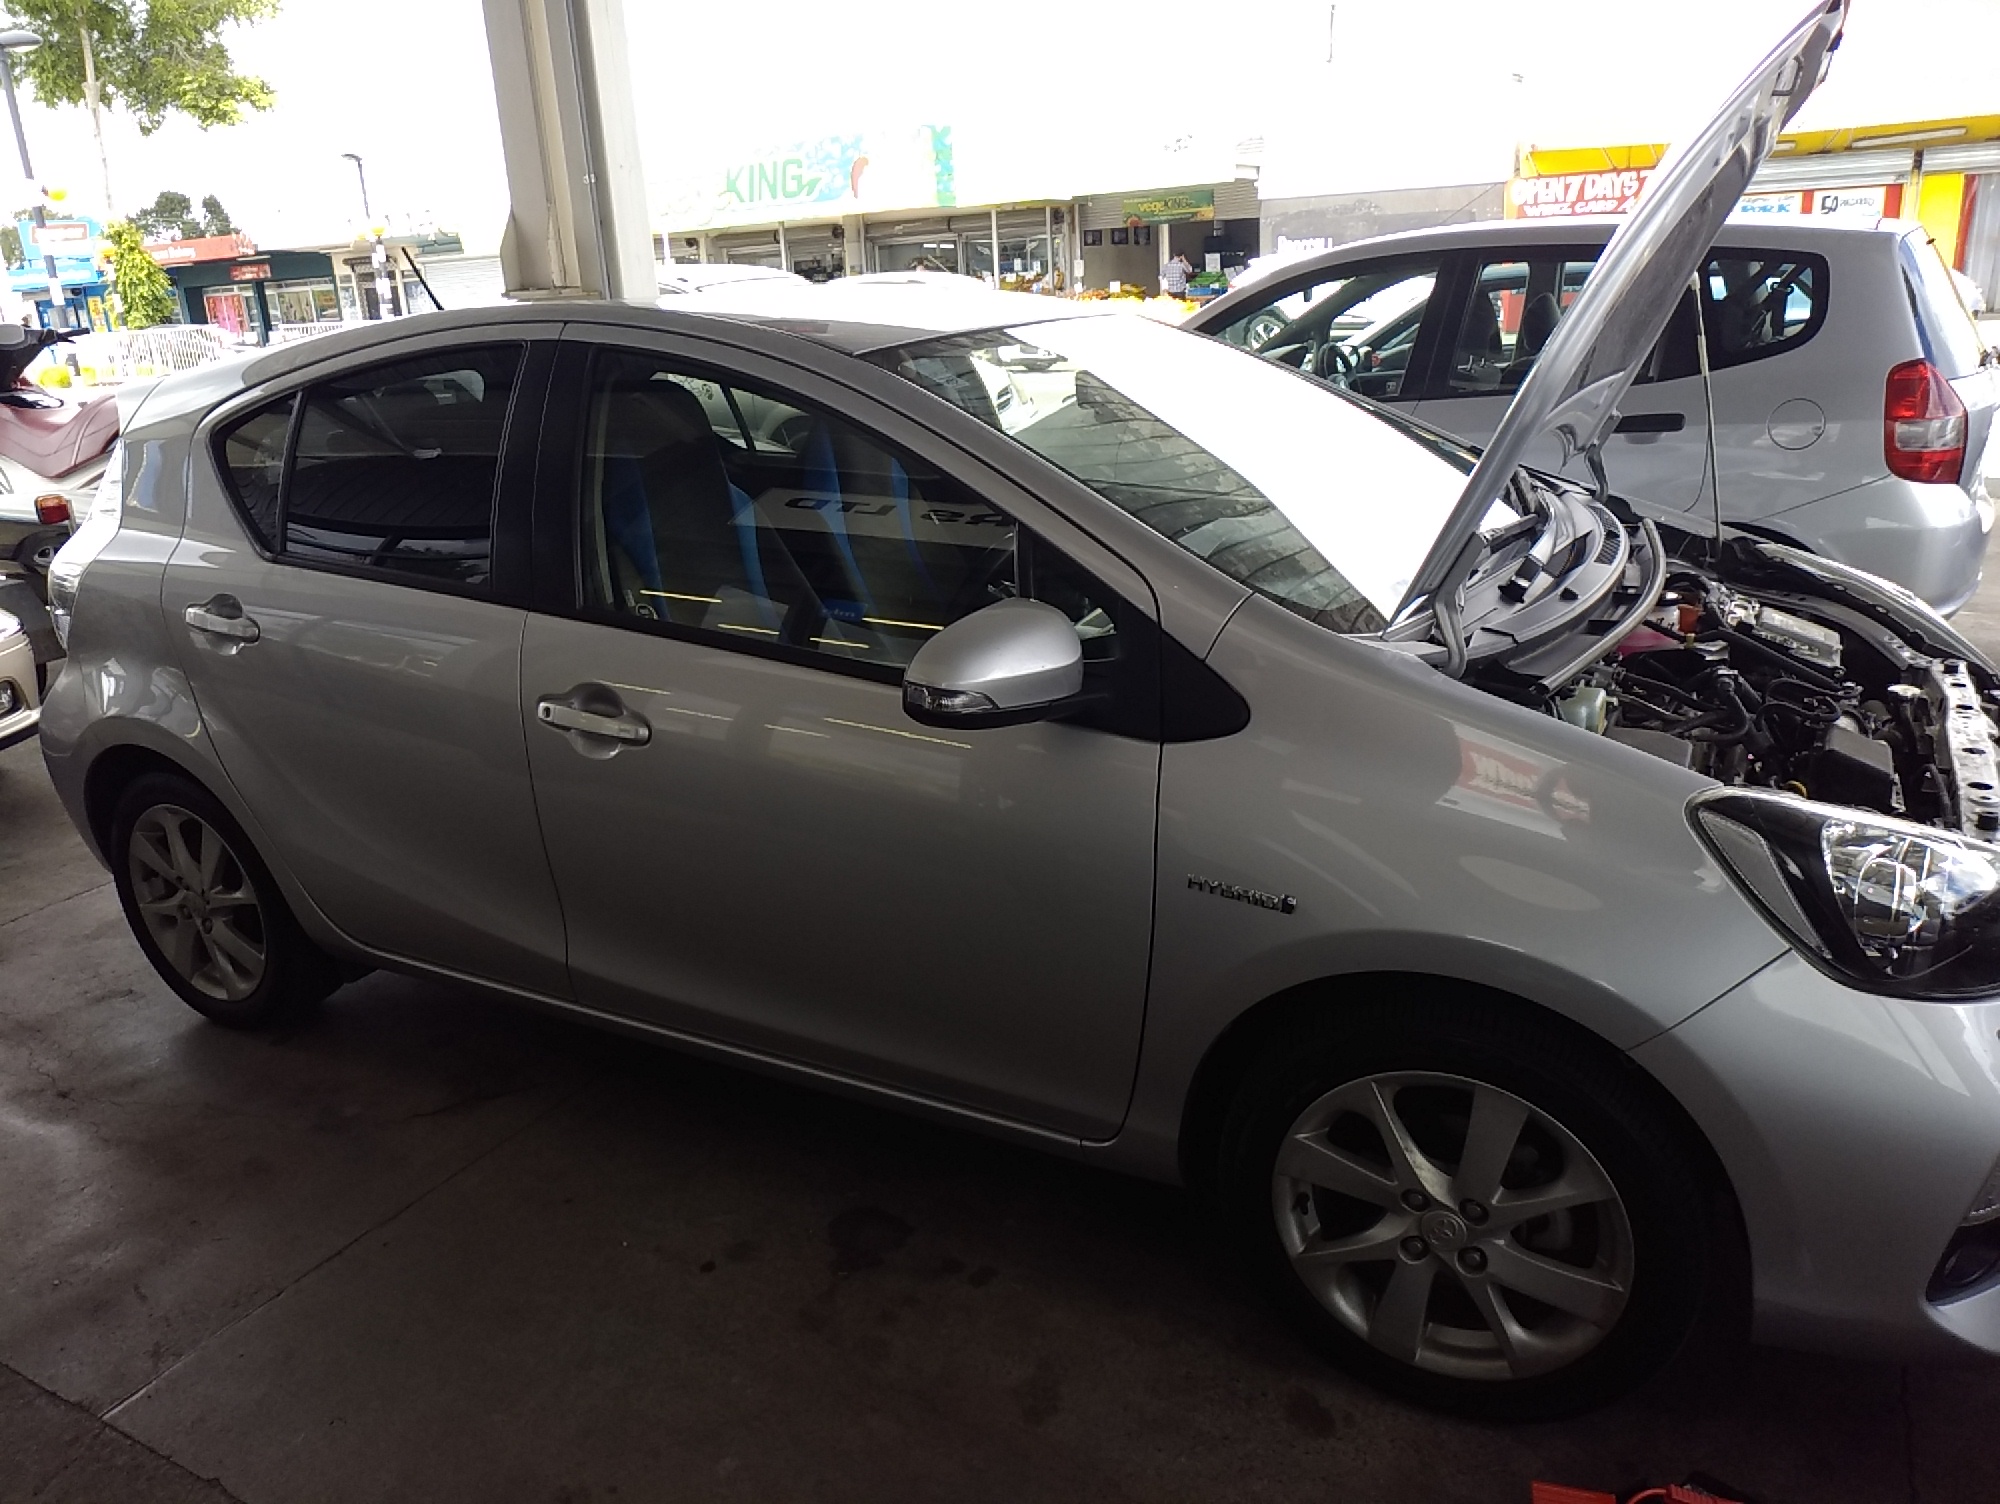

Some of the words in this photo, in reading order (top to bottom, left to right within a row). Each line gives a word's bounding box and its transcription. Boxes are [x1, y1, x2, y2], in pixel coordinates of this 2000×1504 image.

[1511, 177, 1566, 205] OPEN
[1566, 175, 1585, 202] 7
[1584, 171, 1639, 201] DAYS
[1187, 873, 1280, 911] HYBRID
